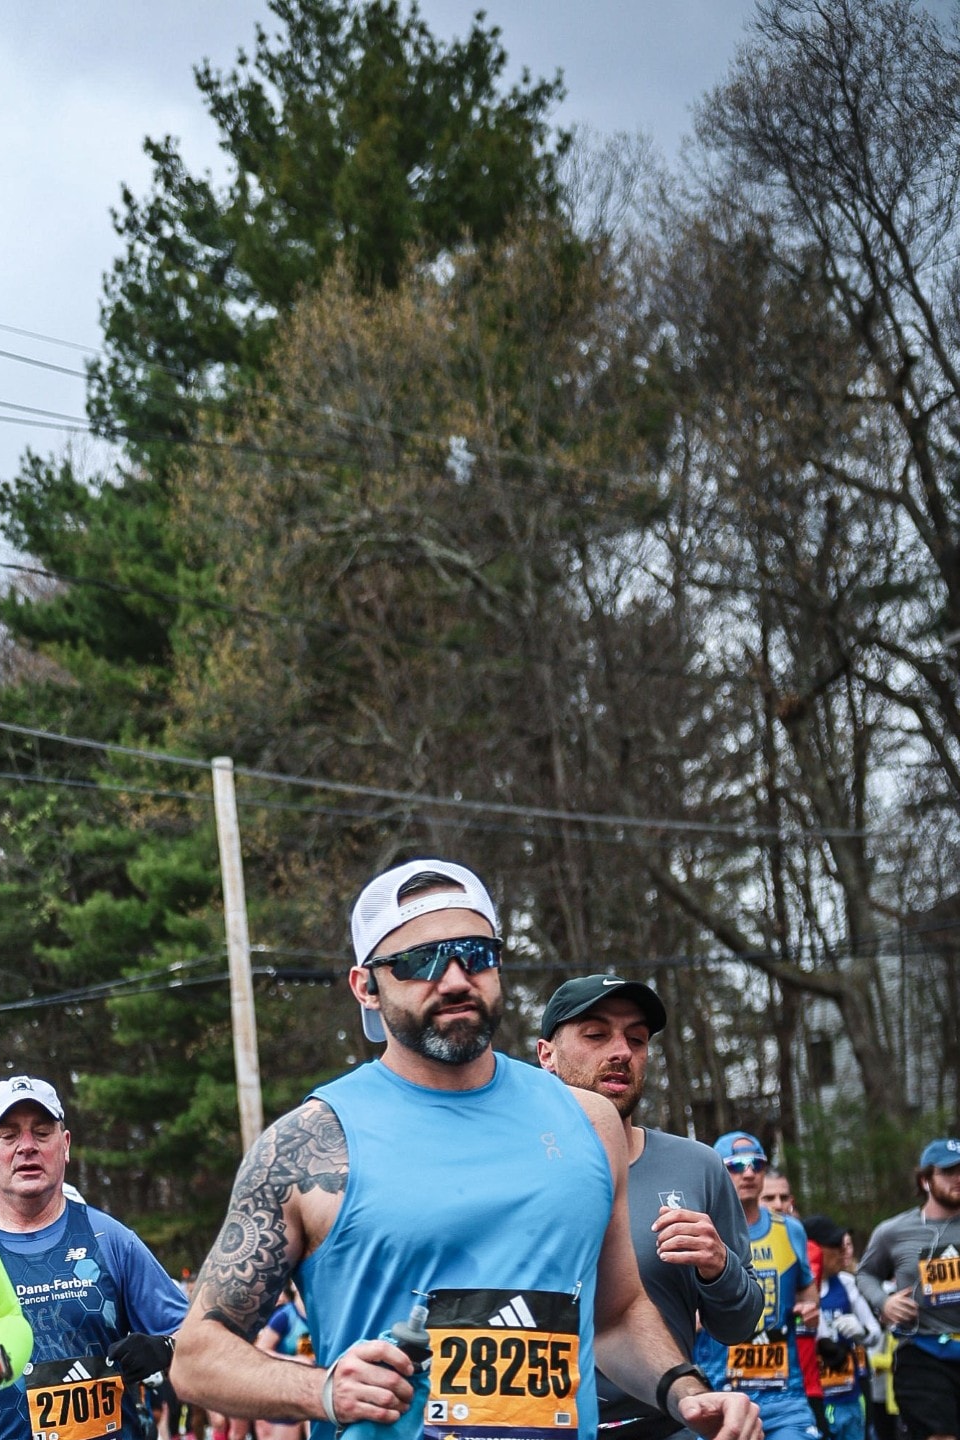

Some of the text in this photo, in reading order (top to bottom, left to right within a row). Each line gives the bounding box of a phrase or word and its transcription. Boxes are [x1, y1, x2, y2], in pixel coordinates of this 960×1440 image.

[926, 1262, 960, 1283] 301
[16, 1278, 94, 1296] Dana-Farber
[18, 1290, 88, 1306] Cancer Institute
[440, 1336, 572, 1399] 28255
[36, 1381, 117, 1429] 27015
[431, 1403, 445, 1419] 2
